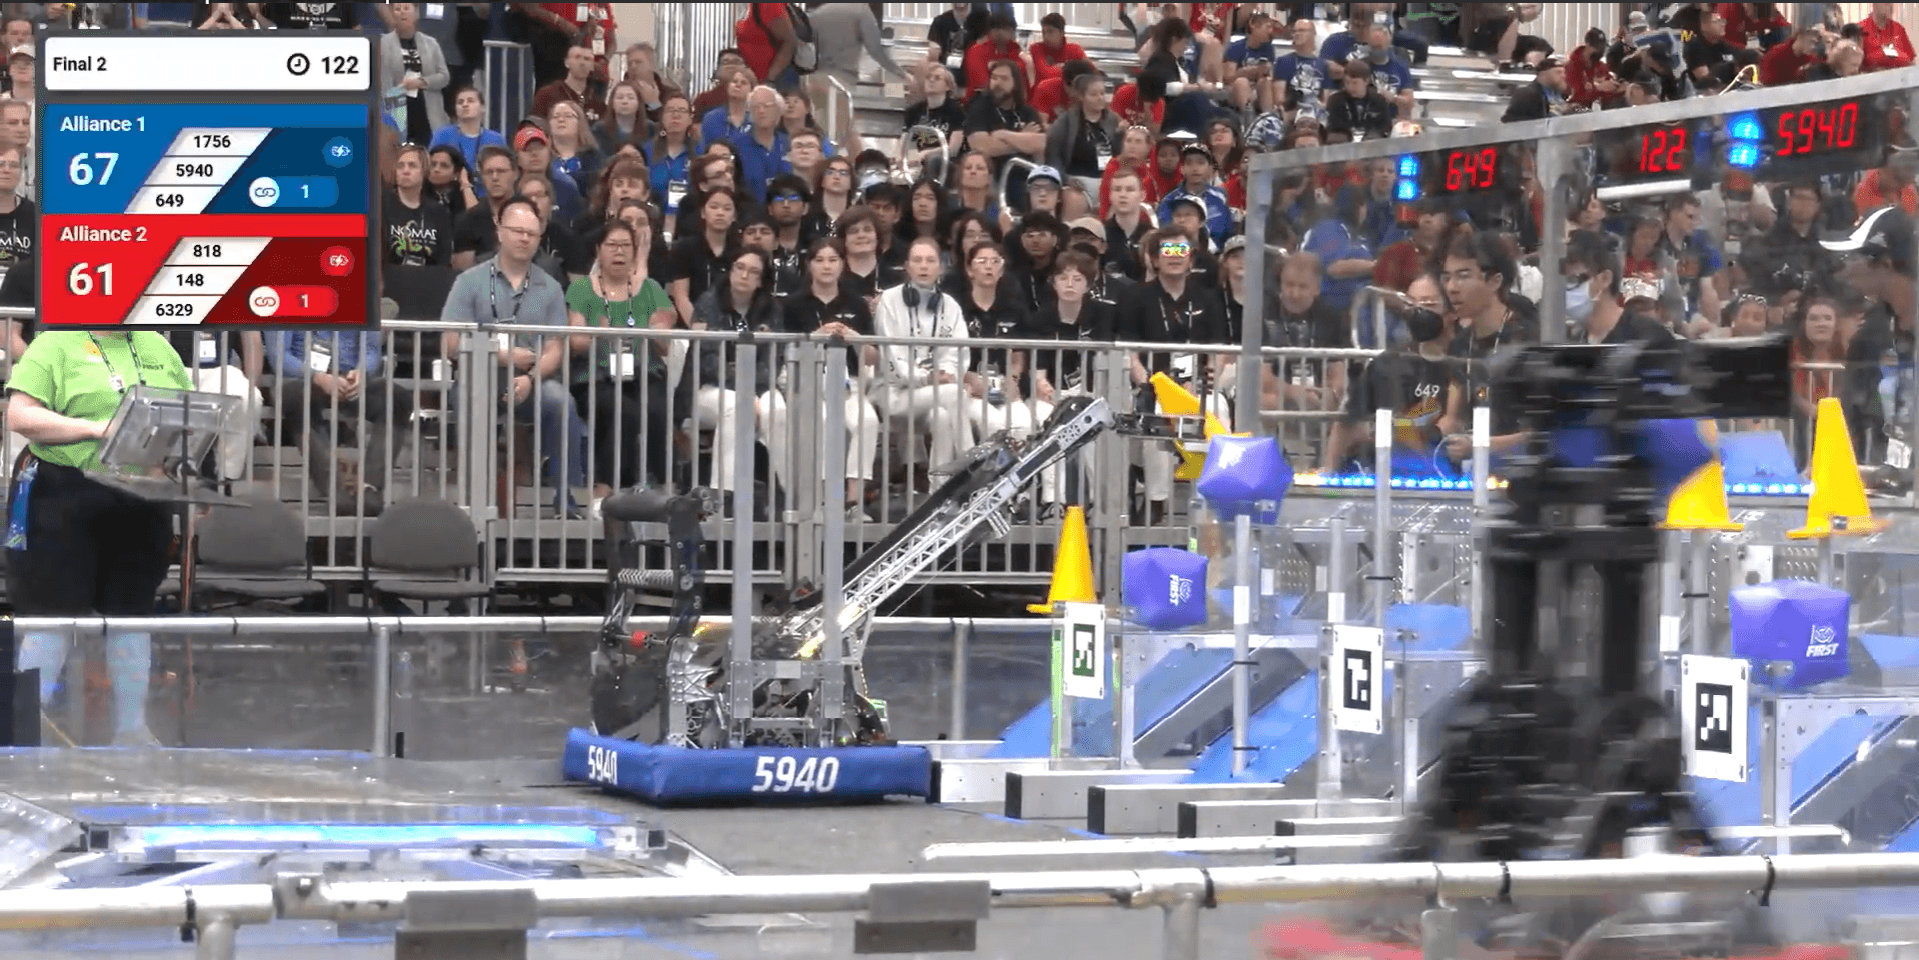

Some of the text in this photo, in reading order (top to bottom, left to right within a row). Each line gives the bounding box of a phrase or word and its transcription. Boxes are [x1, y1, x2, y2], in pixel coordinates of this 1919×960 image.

[1776, 102, 1858, 156] 5940
[1446, 147, 1497, 191] 649
[1640, 127, 1686, 173] 122
[1414, 382, 1440, 398] 649
[1169, 574, 1179, 606] FIRST
[1806, 642, 1839, 657] FIRST
[587, 744, 618, 785] 5940
[752, 755, 840, 792] 5940
